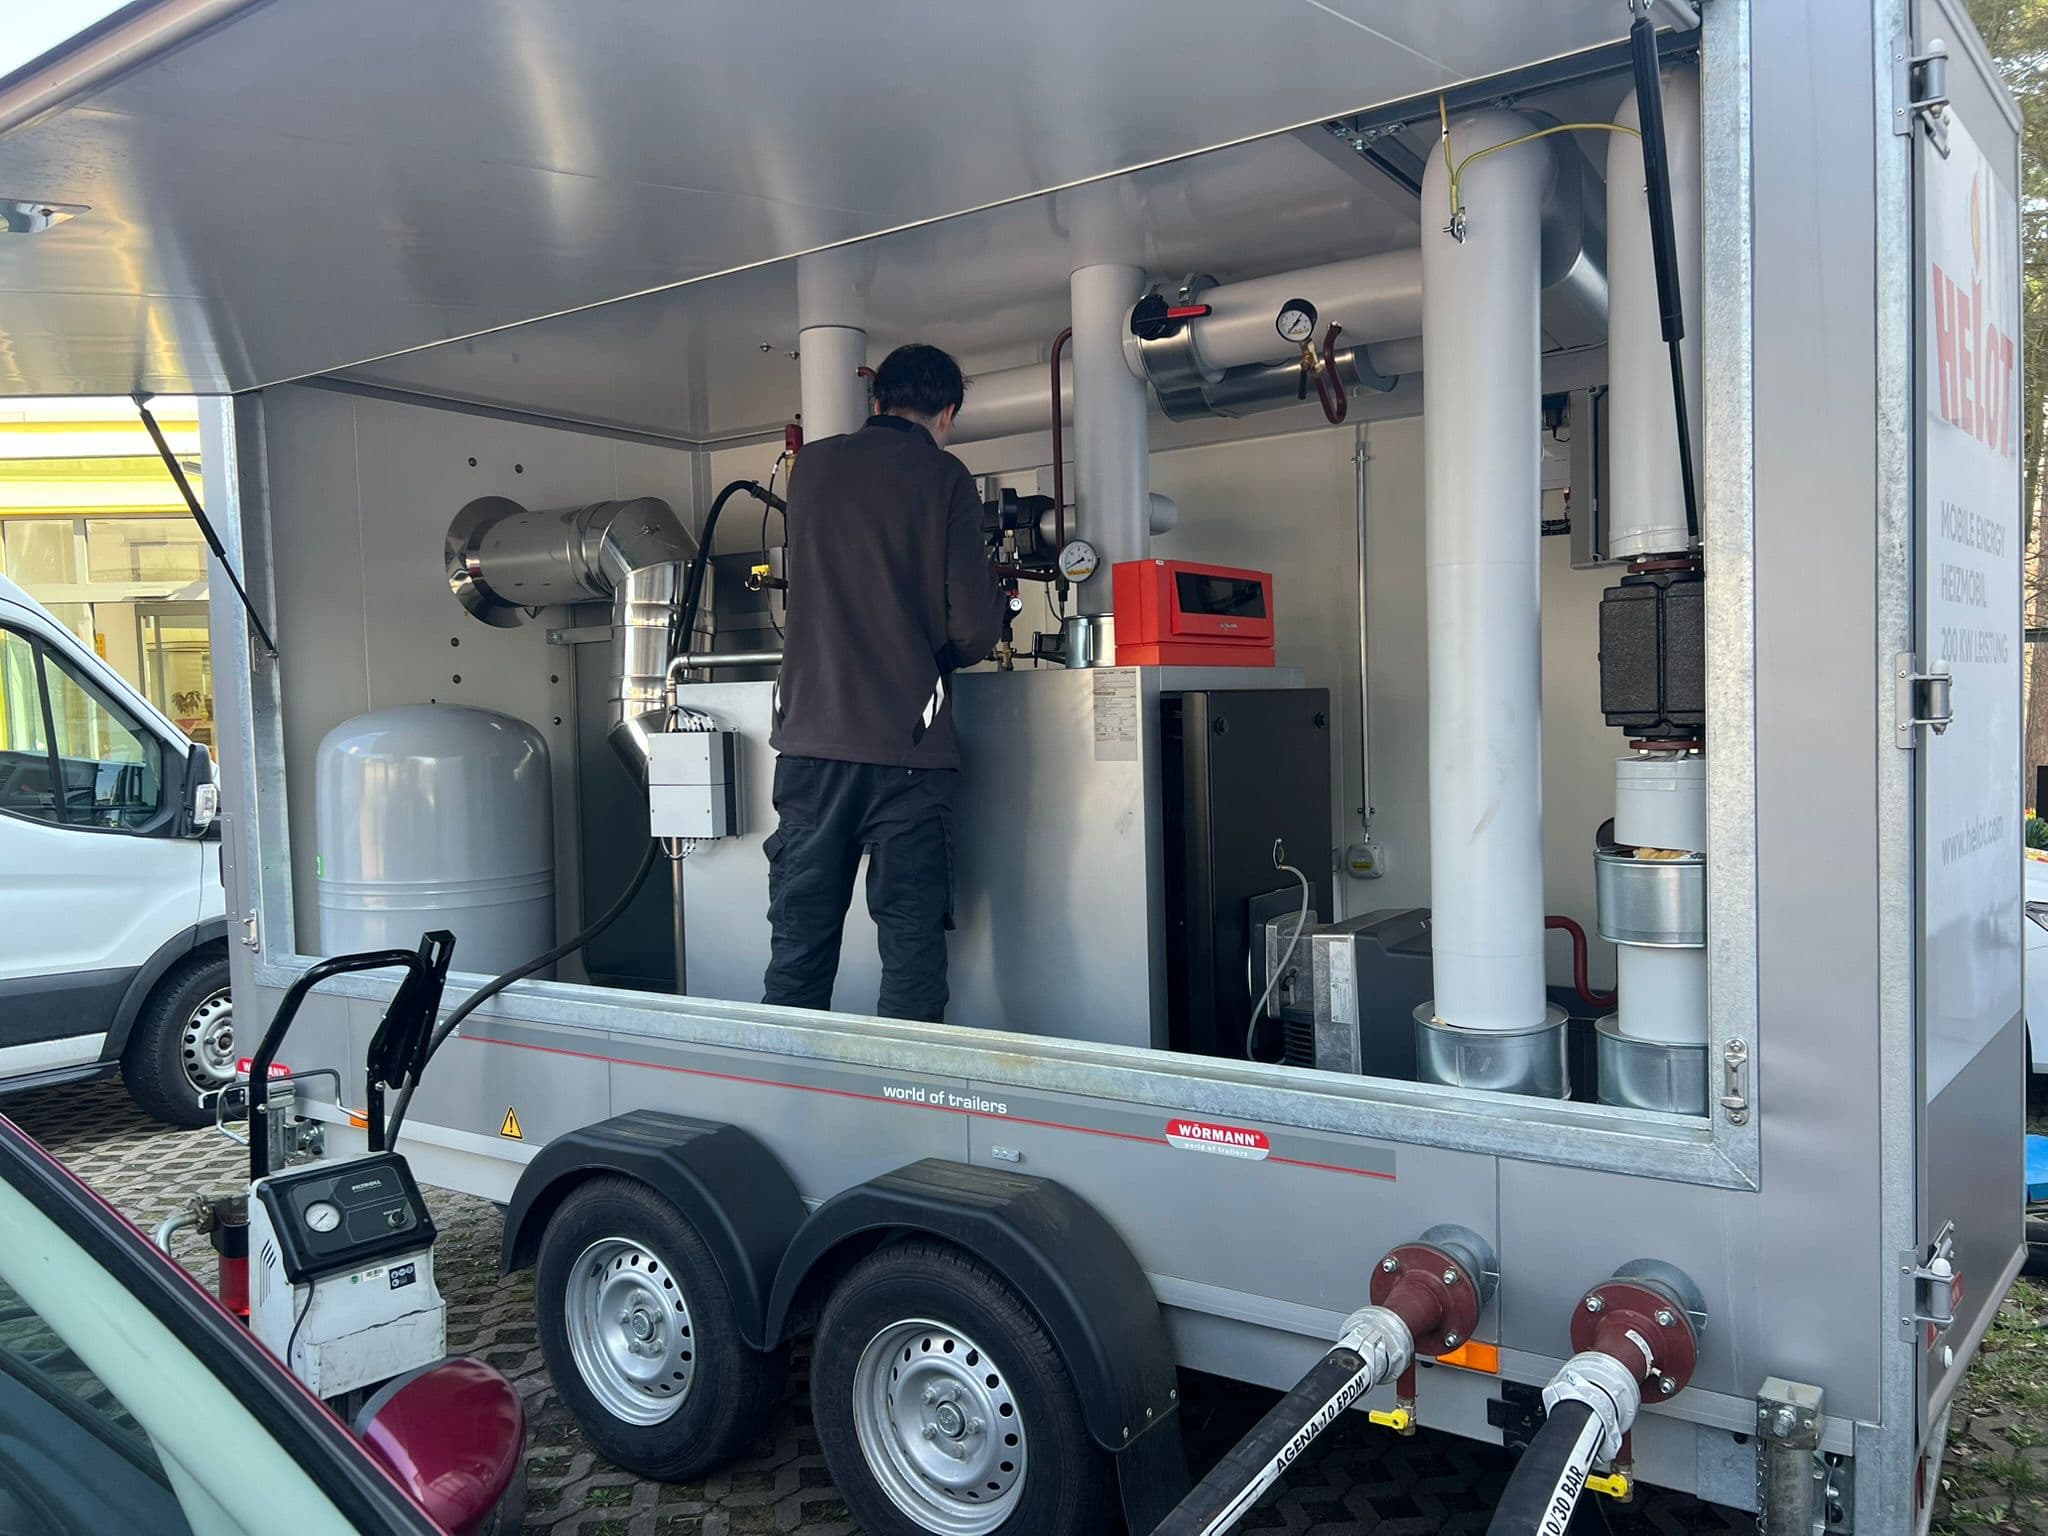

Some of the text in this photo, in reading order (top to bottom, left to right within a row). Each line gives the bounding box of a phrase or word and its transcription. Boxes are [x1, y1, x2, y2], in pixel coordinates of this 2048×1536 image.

[1932, 261, 2014, 458] HELOT
[1941, 500, 2006, 558] MOBILE ENERGY
[1941, 563, 1987, 608] HEIZMOBIL
[1975, 630, 2008, 664] LEISTUNG
[883, 1086, 1007, 1114] world of trailers
[1184, 1142, 1248, 1157] world of trailers
[1561, 1465, 1584, 1499] BAR
